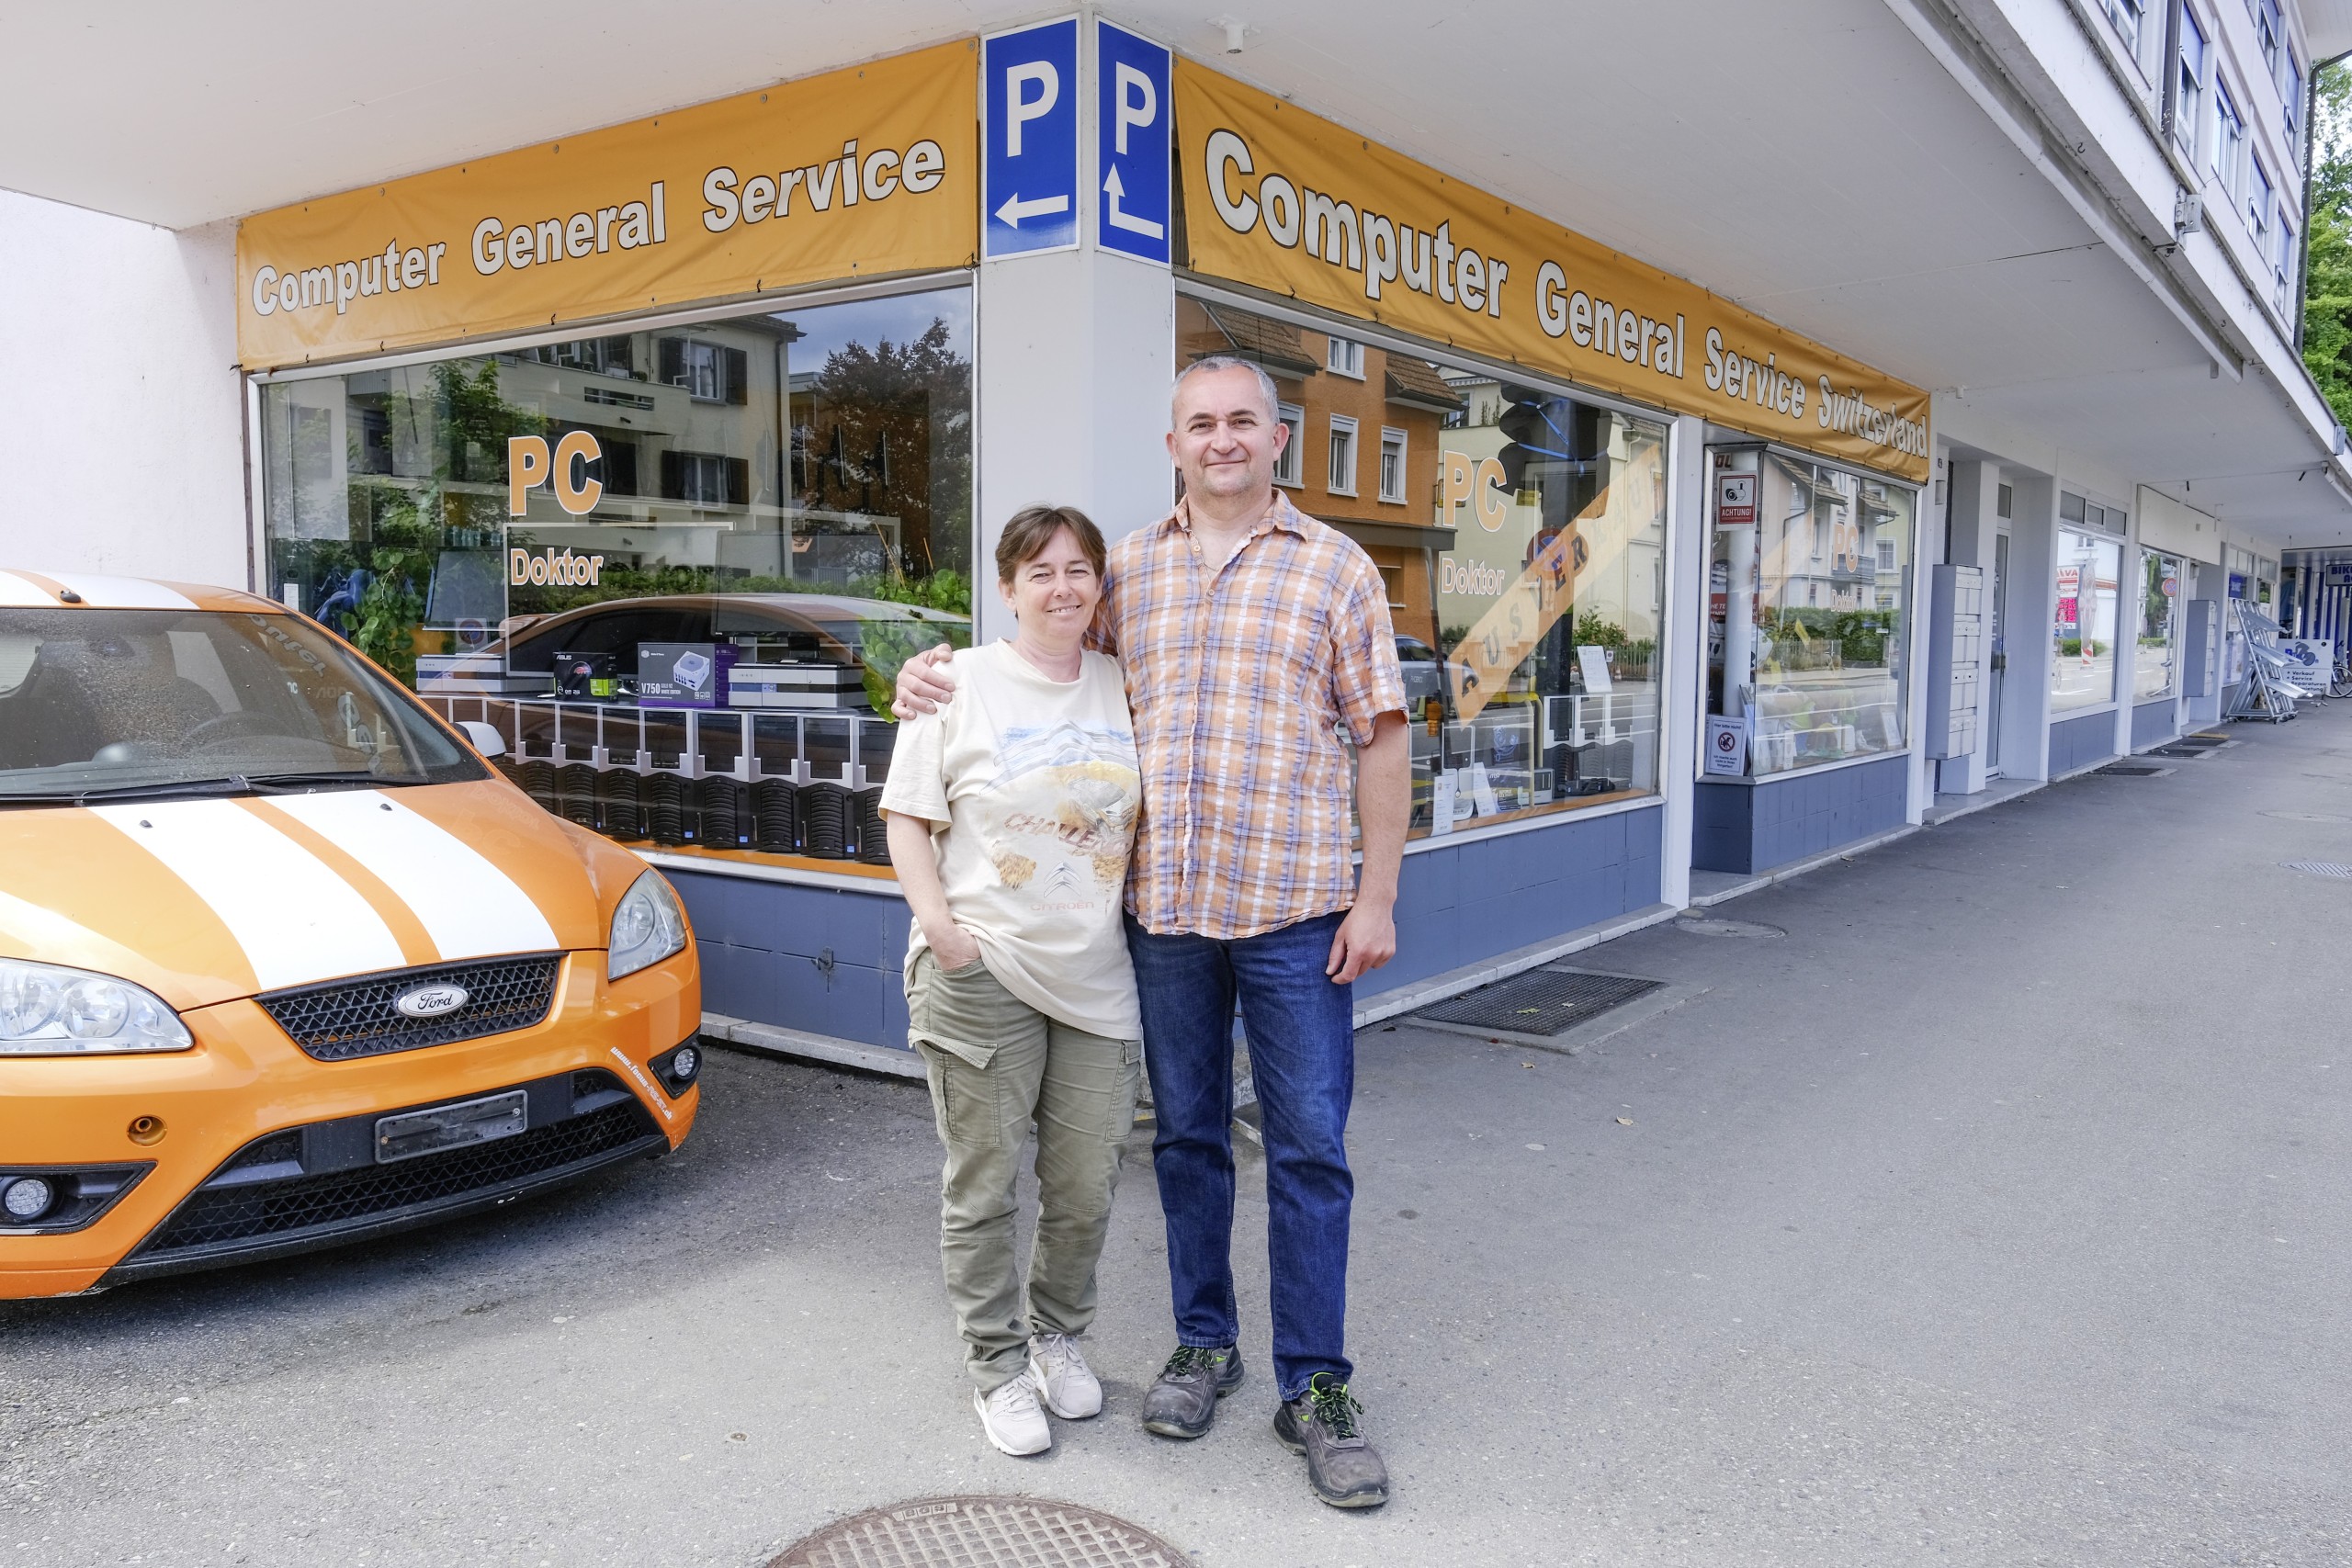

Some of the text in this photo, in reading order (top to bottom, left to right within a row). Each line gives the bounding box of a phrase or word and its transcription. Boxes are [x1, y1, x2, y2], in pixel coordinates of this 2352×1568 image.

[1006, 60, 1059, 158] P
[1114, 61, 1158, 155] P
[251, 137, 946, 317] Computer General Service
[1204, 128, 1928, 459] Computer General Service Switzerland
[508, 430, 604, 516] PC
[1442, 449, 1508, 533] PC
[1721, 508, 1752, 516] ACHTUNG!
[511, 546, 605, 586] Doktor
[1441, 557, 1506, 595] Doktor
[1461, 462, 1659, 697] AUSVERKAU
[1832, 523, 1859, 573] PC
[1830, 589, 1856, 614] Doktor
[641, 682, 661, 694] V750
[417, 991, 453, 1010] Ford
